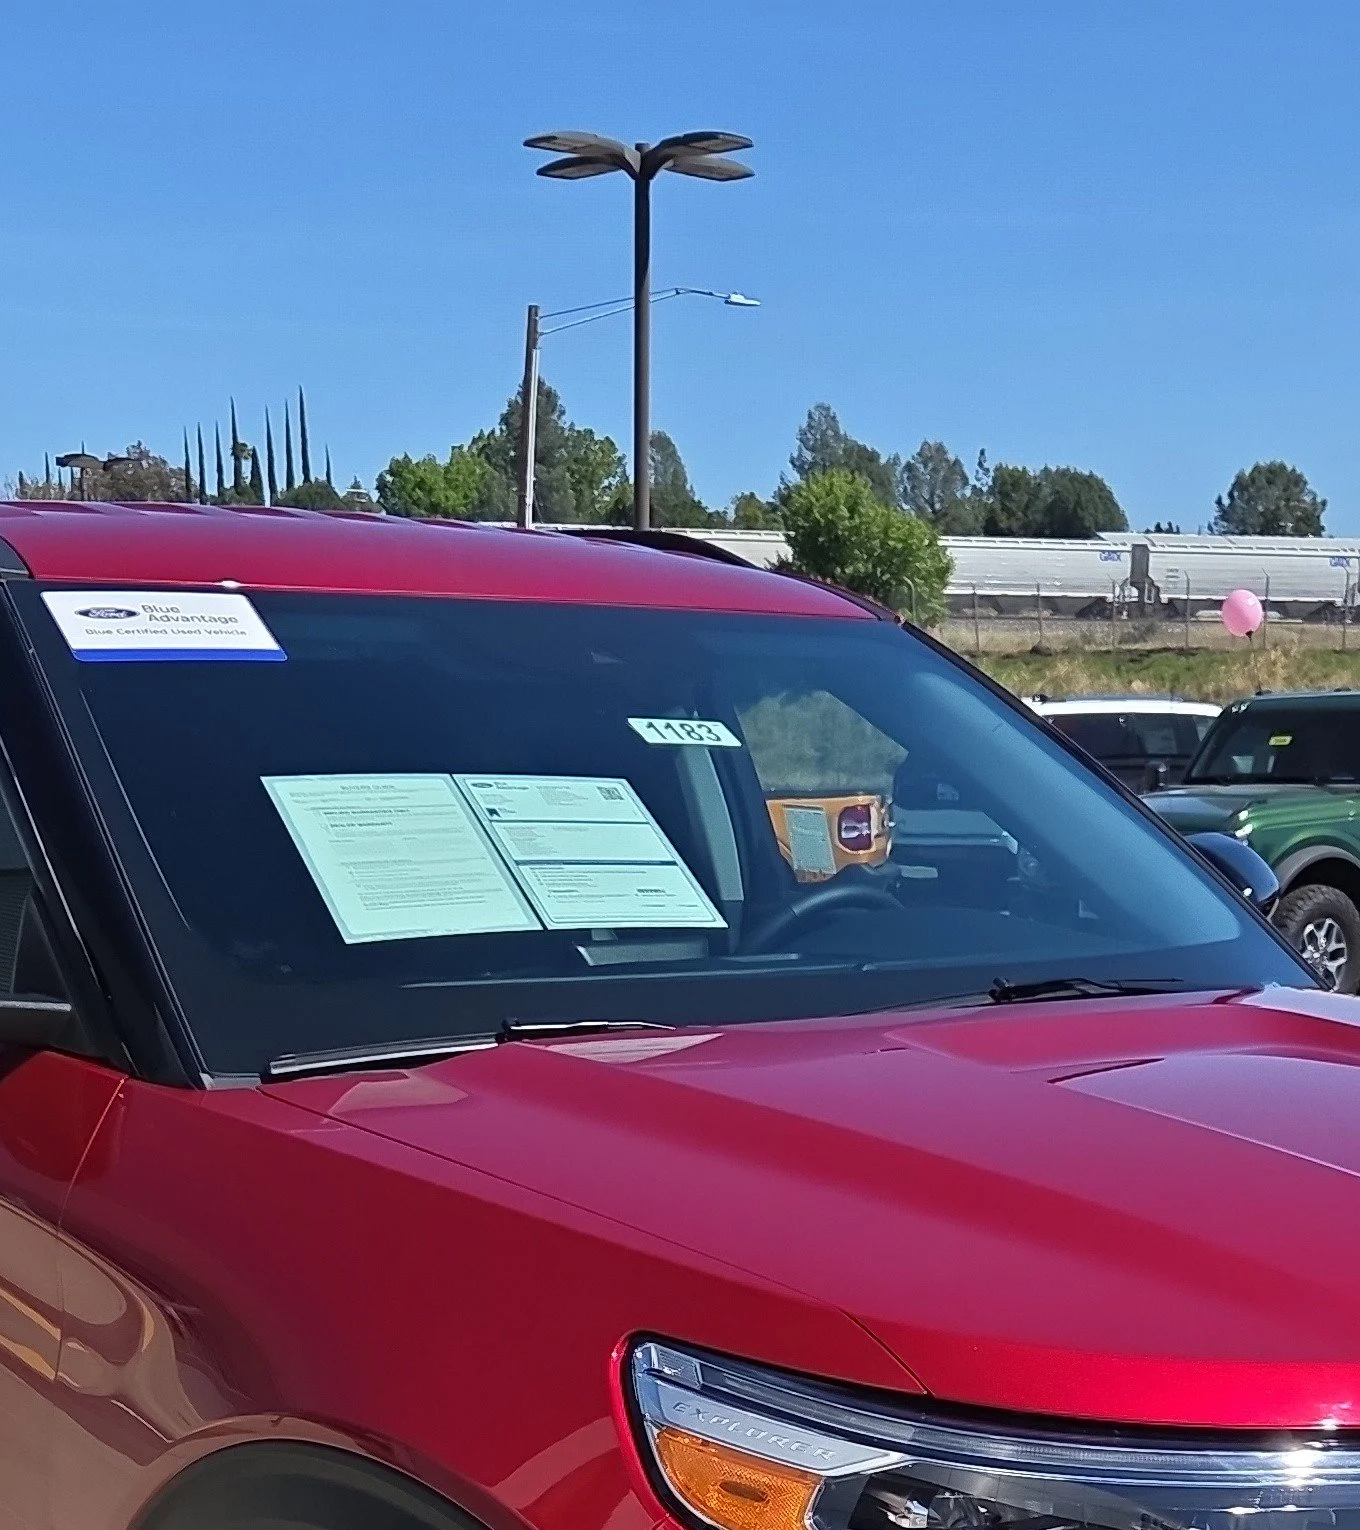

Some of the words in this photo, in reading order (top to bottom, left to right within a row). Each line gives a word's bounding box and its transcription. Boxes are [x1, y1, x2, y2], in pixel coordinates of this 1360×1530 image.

[140, 604, 181, 615] Blue
[148, 613, 239, 624] Advantage
[84, 627, 113, 636] Blue
[116, 628, 168, 636] Certified
[170, 628, 202, 636] Used
[206, 628, 247, 637] Vehicle
[645, 720, 722, 743] 1183
[672, 1401, 837, 1462] EXPLORER
